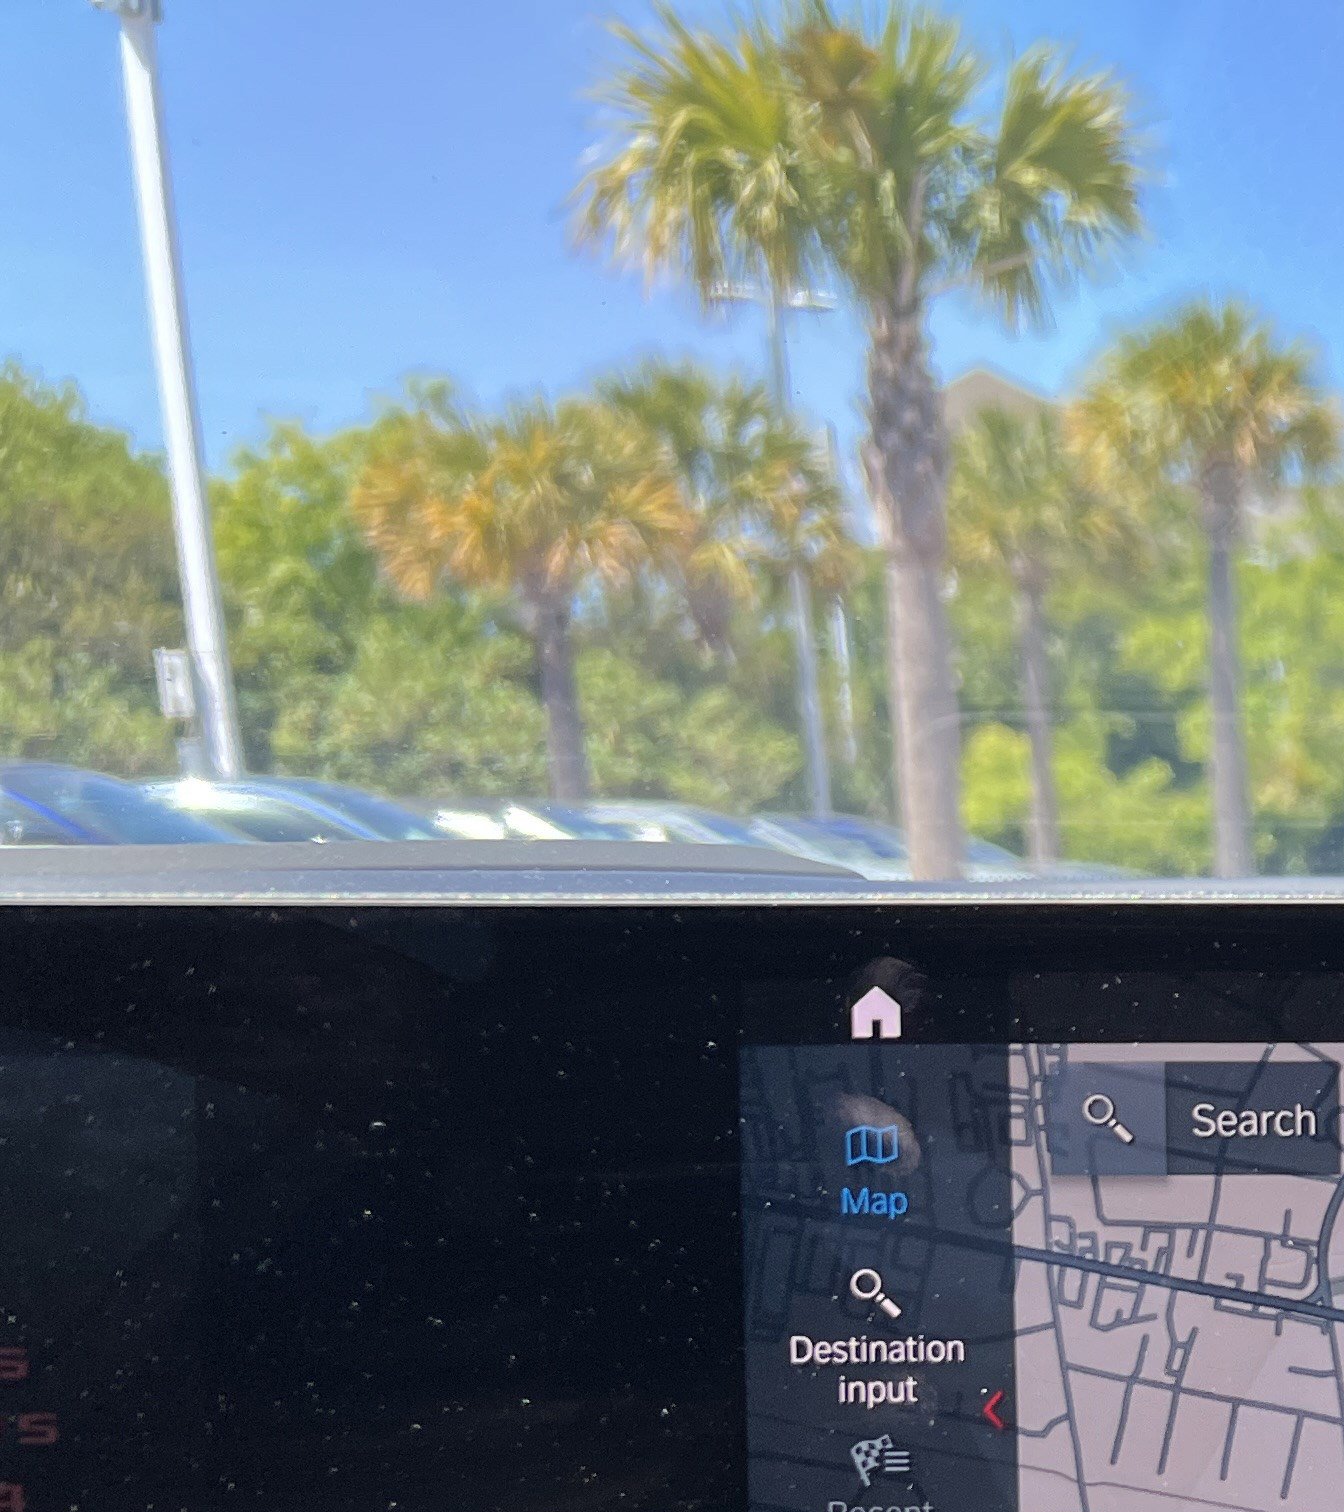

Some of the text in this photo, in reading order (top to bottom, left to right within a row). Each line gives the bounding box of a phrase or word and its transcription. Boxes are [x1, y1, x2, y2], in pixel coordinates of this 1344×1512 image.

[1192, 1103, 1316, 1137] Search
[840, 1186, 909, 1220] Map
[789, 1334, 965, 1365] Destination
[838, 1375, 919, 1409] input
